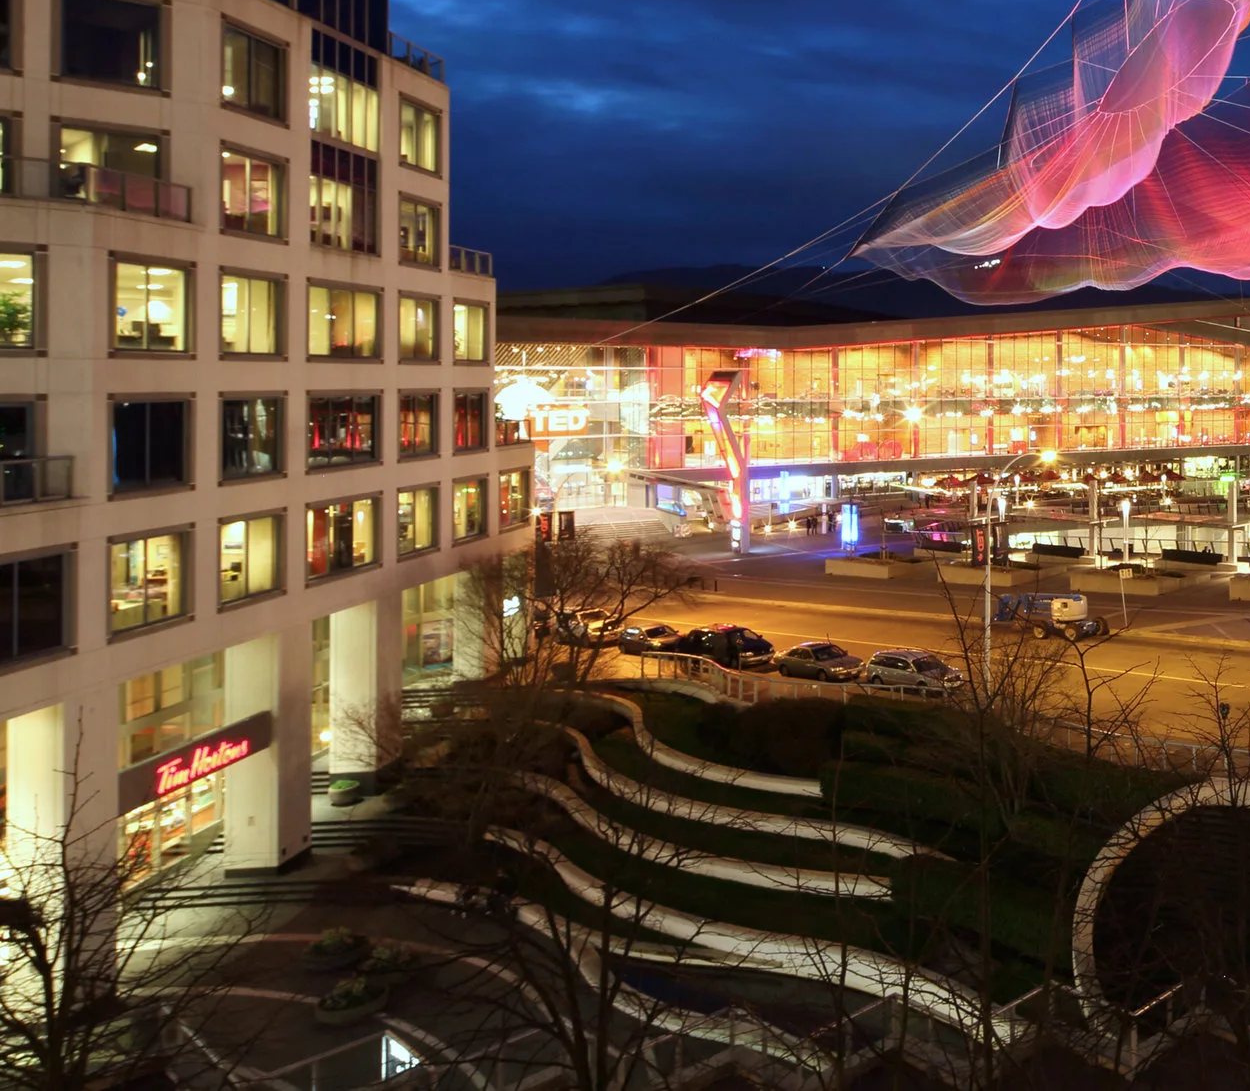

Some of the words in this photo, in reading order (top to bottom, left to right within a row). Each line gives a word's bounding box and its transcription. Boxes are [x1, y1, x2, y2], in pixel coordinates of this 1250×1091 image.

[530, 409, 588, 432] TED
[156, 758, 190, 795] Tim
[189, 738, 249, 780] Hortons
